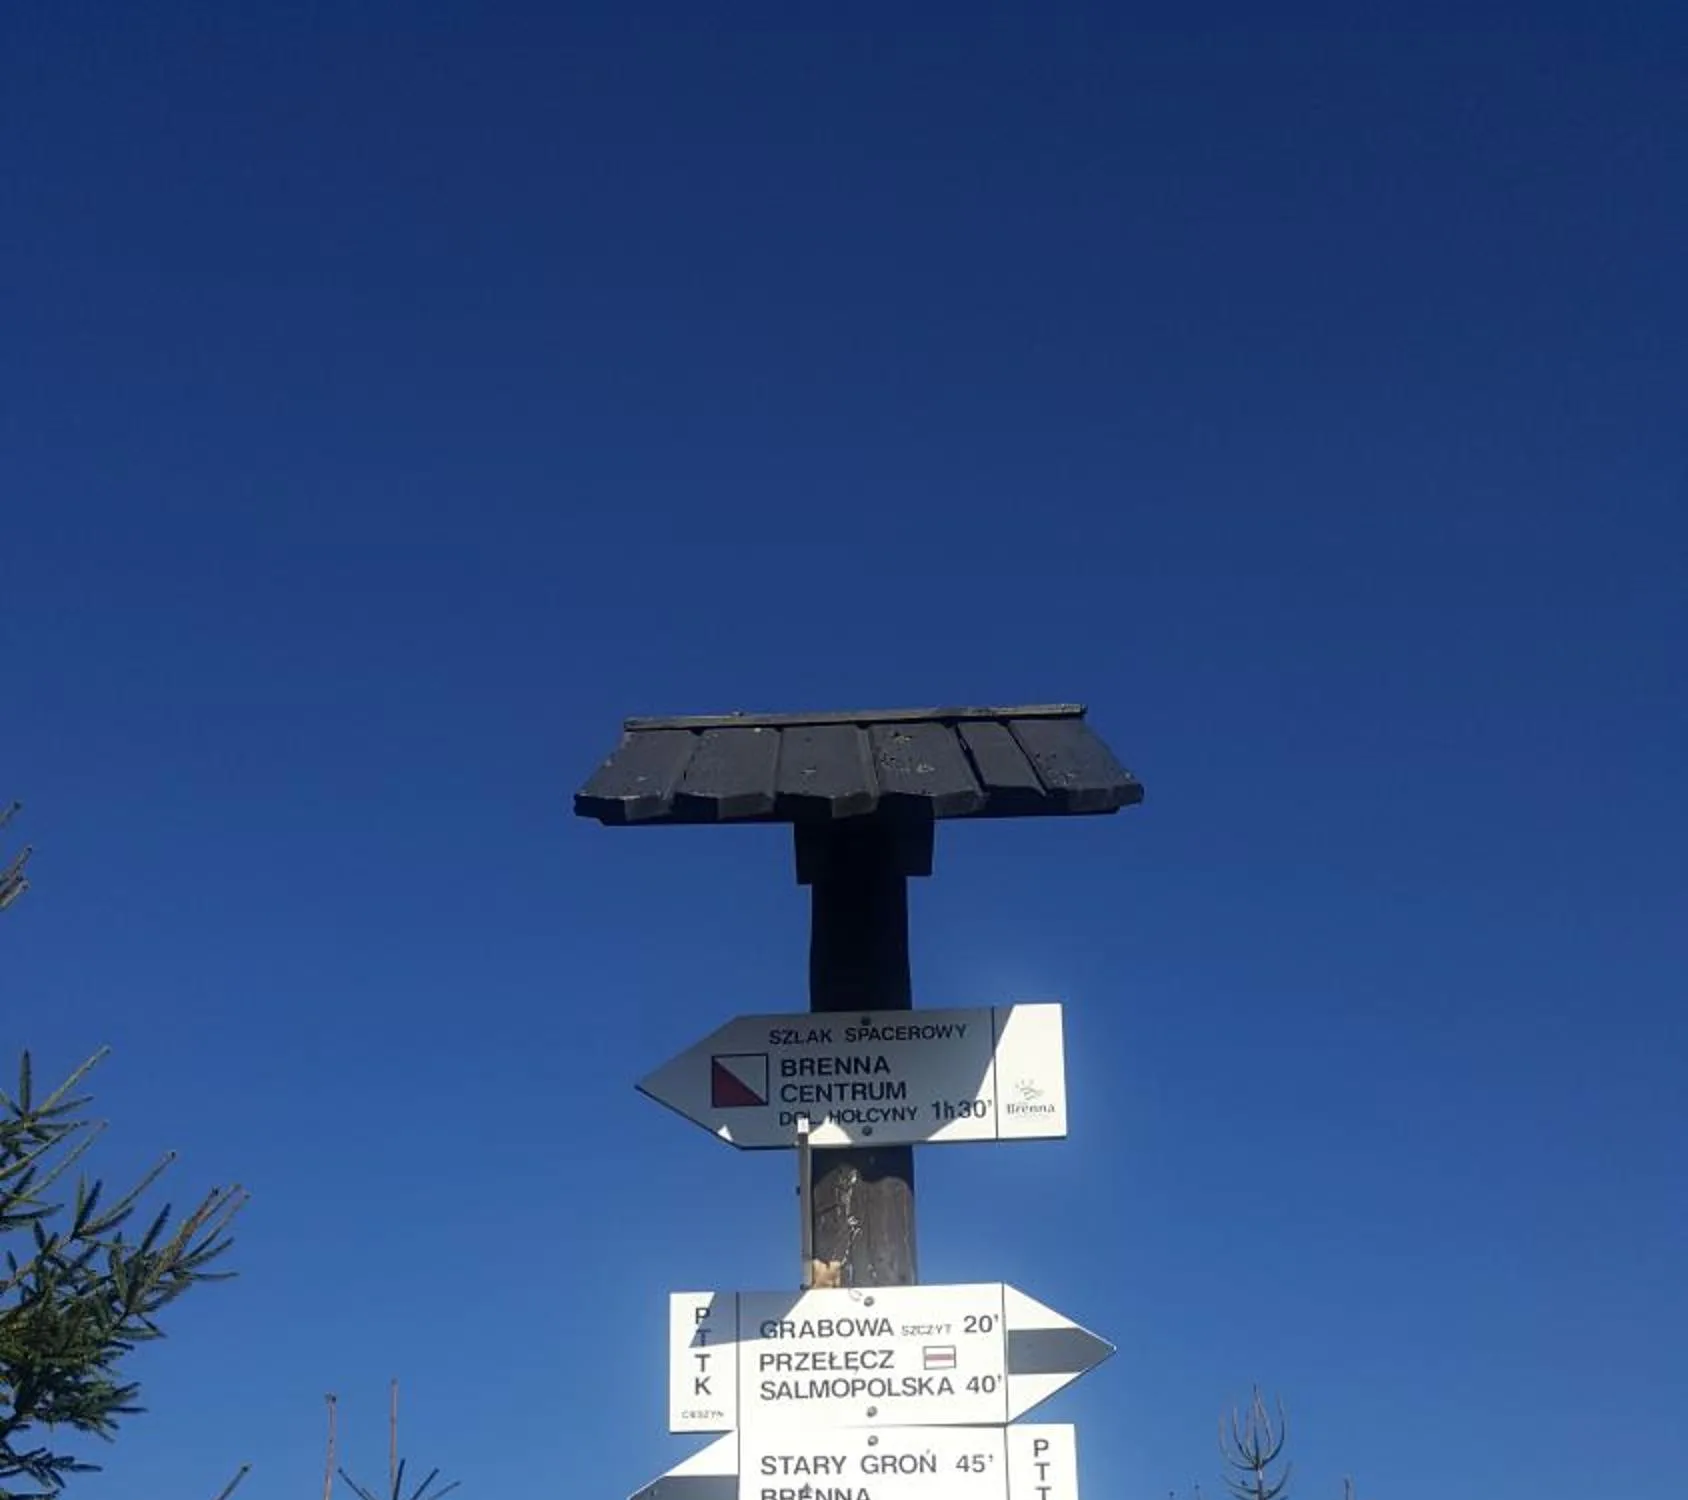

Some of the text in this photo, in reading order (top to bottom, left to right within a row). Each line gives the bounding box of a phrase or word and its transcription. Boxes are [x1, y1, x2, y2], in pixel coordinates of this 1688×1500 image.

[768, 1023, 968, 1045] SZLAK SPACEROWY
[781, 1055, 891, 1077] BRENNA
[780, 1081, 907, 1103] CENTRUM
[759, 1314, 999, 1339] GRABOWA SZCZYT 20'
[759, 1349, 895, 1374] PRZEŁĘCZ
[760, 1374, 1002, 1401] SALMOPOLSKA 40'
[760, 1448, 994, 1475] STARY GROŃ 45'
